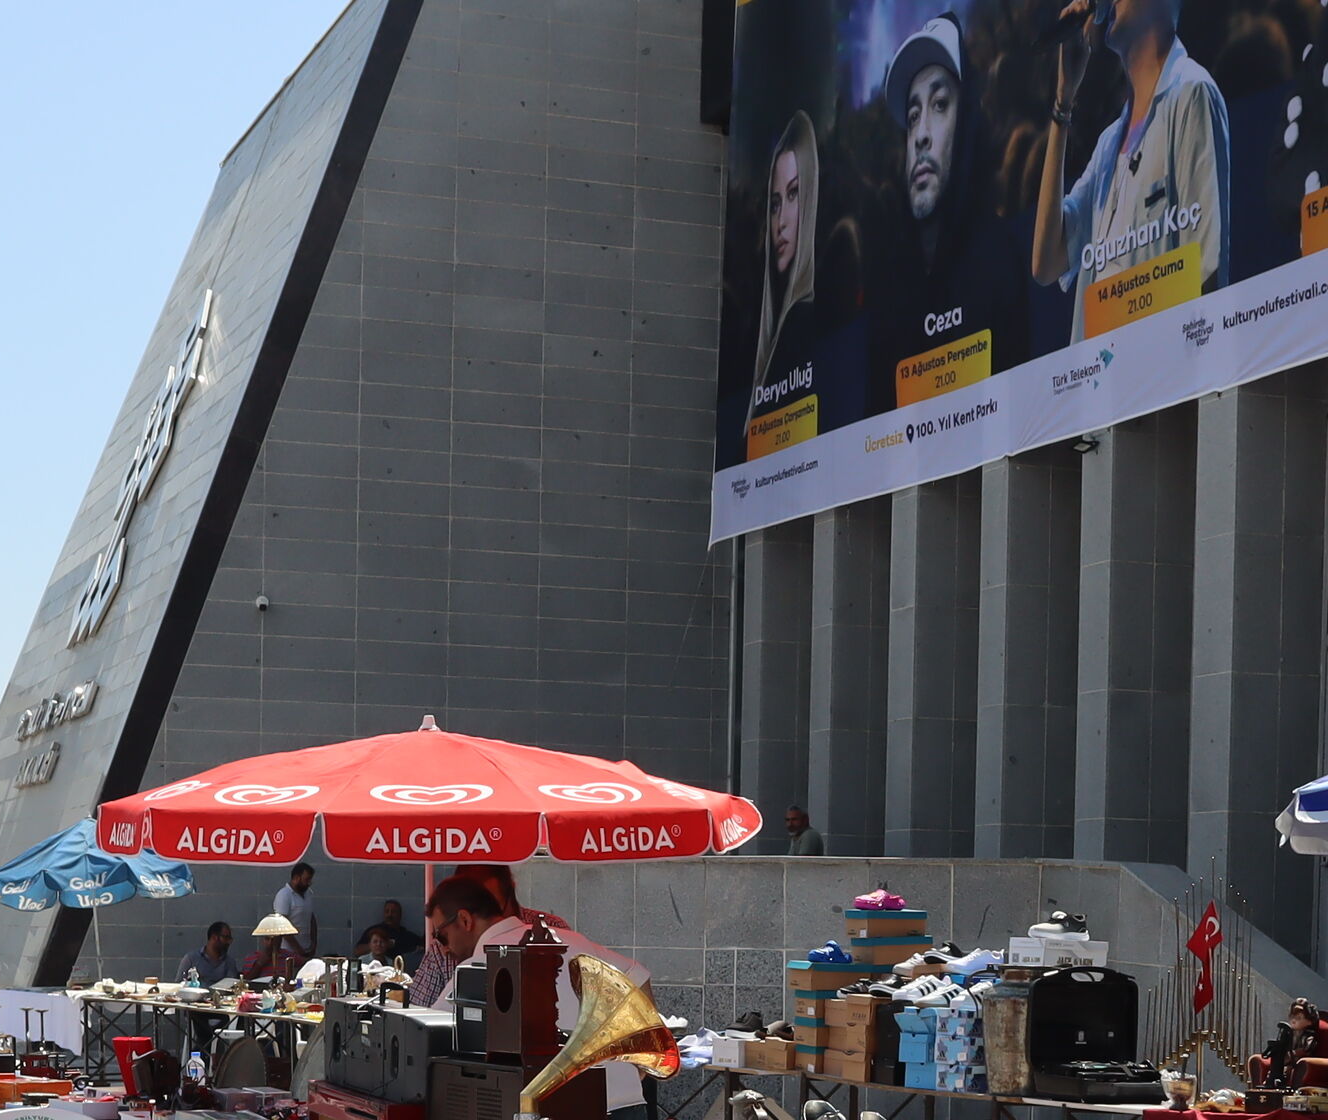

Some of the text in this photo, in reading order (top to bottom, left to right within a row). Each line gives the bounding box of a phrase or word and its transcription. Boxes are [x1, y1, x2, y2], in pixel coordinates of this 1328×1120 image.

[1307, 200, 1319, 219] 15
[1081, 202, 1203, 272] Oğuzhan Koç
[1097, 258, 1184, 303] 14 Ağustos Cuma
[1127, 292, 1153, 315] 21.00
[924, 306, 963, 337] Ceza
[900, 339, 988, 379] 13 Ağustos Perşembe
[1052, 372, 1069, 389] Türk
[1069, 363, 1101, 383] Telekom
[754, 361, 813, 407] Derya Uluğ
[935, 370, 957, 389] 21.00
[864, 398, 998, 454] Ücretsiz 100. Yıl Kent Parkı
